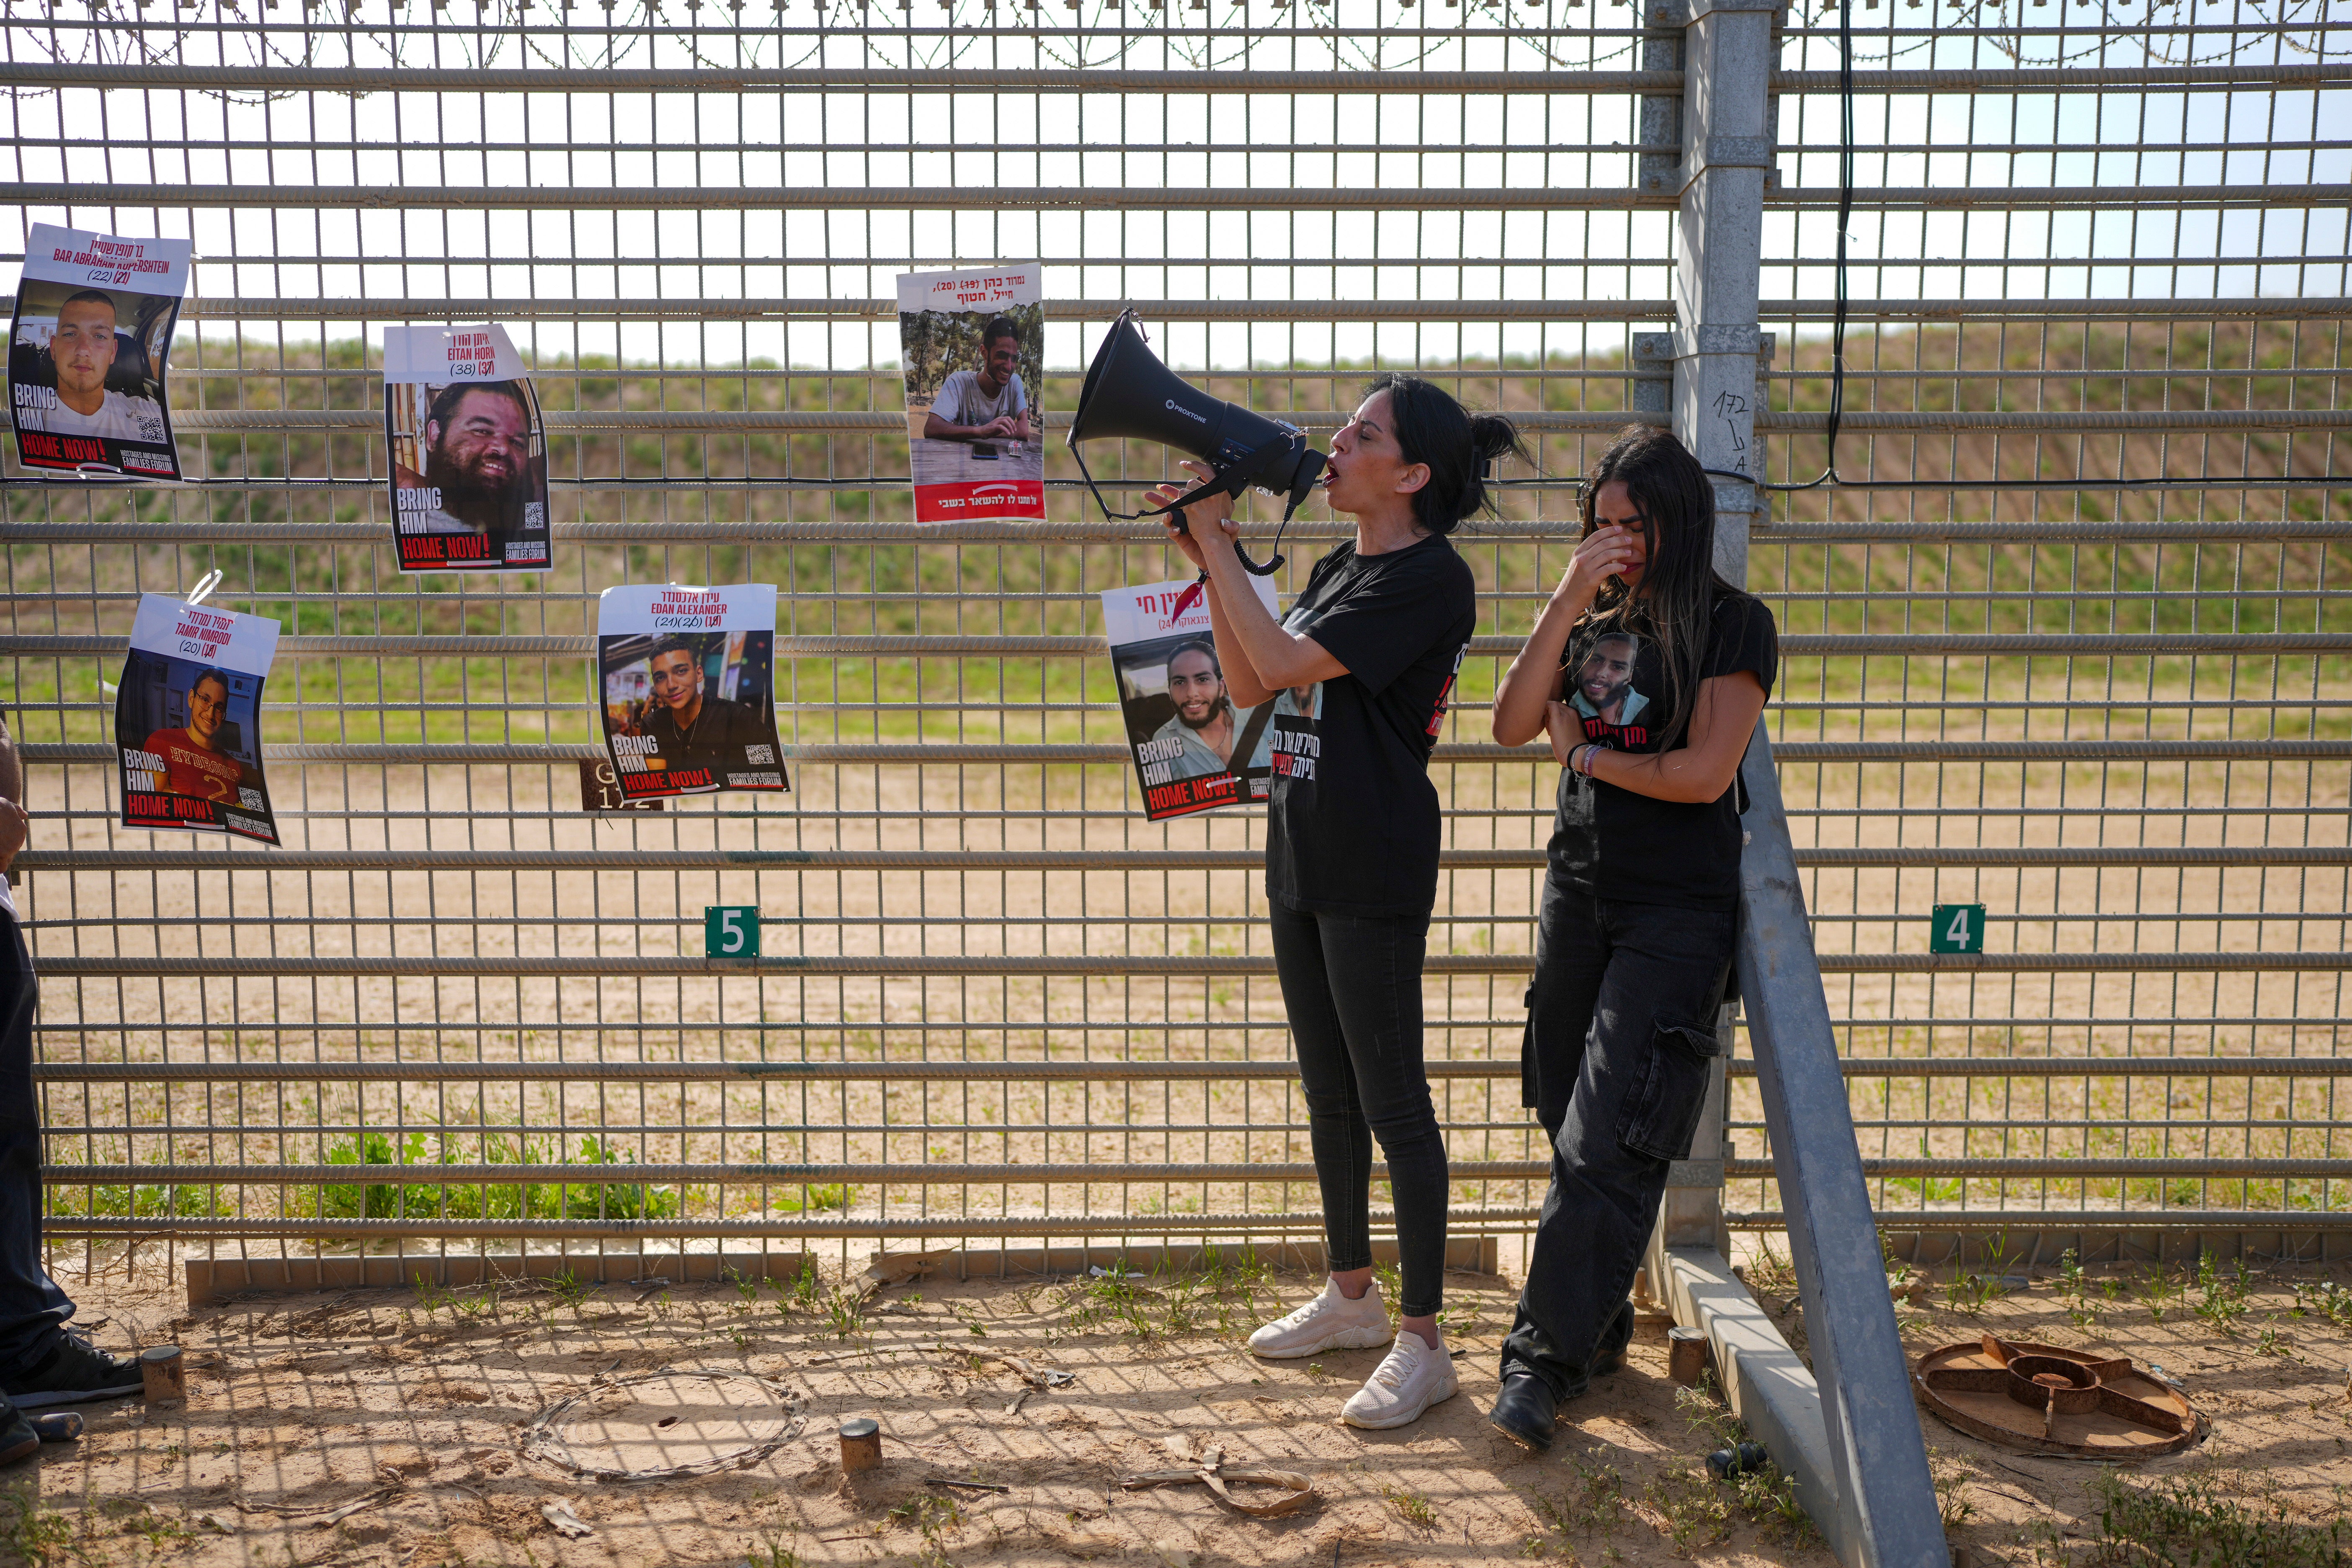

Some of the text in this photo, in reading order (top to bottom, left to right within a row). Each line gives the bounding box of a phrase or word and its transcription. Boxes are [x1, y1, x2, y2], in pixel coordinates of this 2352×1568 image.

[90, 240, 144, 258] בר קופרשטיין
[53, 248, 170, 274] BAR ABRAHAM KUPERSHTEIN
[87, 269, 112, 283] (22)
[983, 278, 1002, 290] כהן
[1006, 275, 1025, 286] נמרוד
[957, 292, 986, 305] חטוף
[453, 333, 490, 348] איתן הורן
[448, 346, 495, 361] EITAN HORN
[450, 363, 475, 377] (38)
[14, 383, 57, 410] BRING
[1713, 390, 1749, 418] 172
[17, 407, 44, 431] HIM
[1174, 405, 1207, 423] PROXTONE
[21, 433, 108, 462] HOME NOW!
[120, 449, 171, 462] HOSTAGES AND MISSING
[122, 456, 174, 472] FAMILIES FORUM
[1734, 455, 1747, 472] A
[396, 487, 442, 511] BRING
[938, 498, 965, 508] בשבי
[968, 494, 1005, 506] להשאר
[1007, 494, 1016, 504] לו
[398, 512, 428, 534] HIM
[401, 533, 490, 559] HOME NOW!
[505, 542, 524, 550] HOSTAGES
[530, 540, 545, 549] MISSING
[505, 548, 546, 560] FAMILIES FORUM
[661, 591, 720, 604] עידן אלכסנדר
[1136, 596, 1156, 614] חי
[651, 603, 727, 615] EDAN ALEXANDER
[188, 610, 234, 631] תמיר נמרודי
[1177, 616, 1210, 628] צנגאוקר
[175, 622, 232, 645] TAMIR NIMRODI
[180, 640, 201, 656] (20)
[612, 735, 658, 756] BRING
[1137, 736, 1183, 765] BRING
[123, 748, 166, 773] BRING
[617, 755, 648, 773] HIM
[126, 770, 155, 792] HIM
[623, 768, 713, 792] HOME NOW!
[758, 777, 782, 786] FORUM
[1142, 761, 1173, 787] HIM
[1248, 777, 1270, 786] HOSTAGES
[1148, 771, 1236, 810] HOME NOW!
[127, 794, 215, 821] HOME NOW!
[225, 812, 246, 823] HOSTAGES
[253, 819, 271, 829] MISSING
[227, 818, 273, 838] FAMILIES FORUM
[722, 910, 744, 953] 5
[1946, 909, 1970, 950] 4
